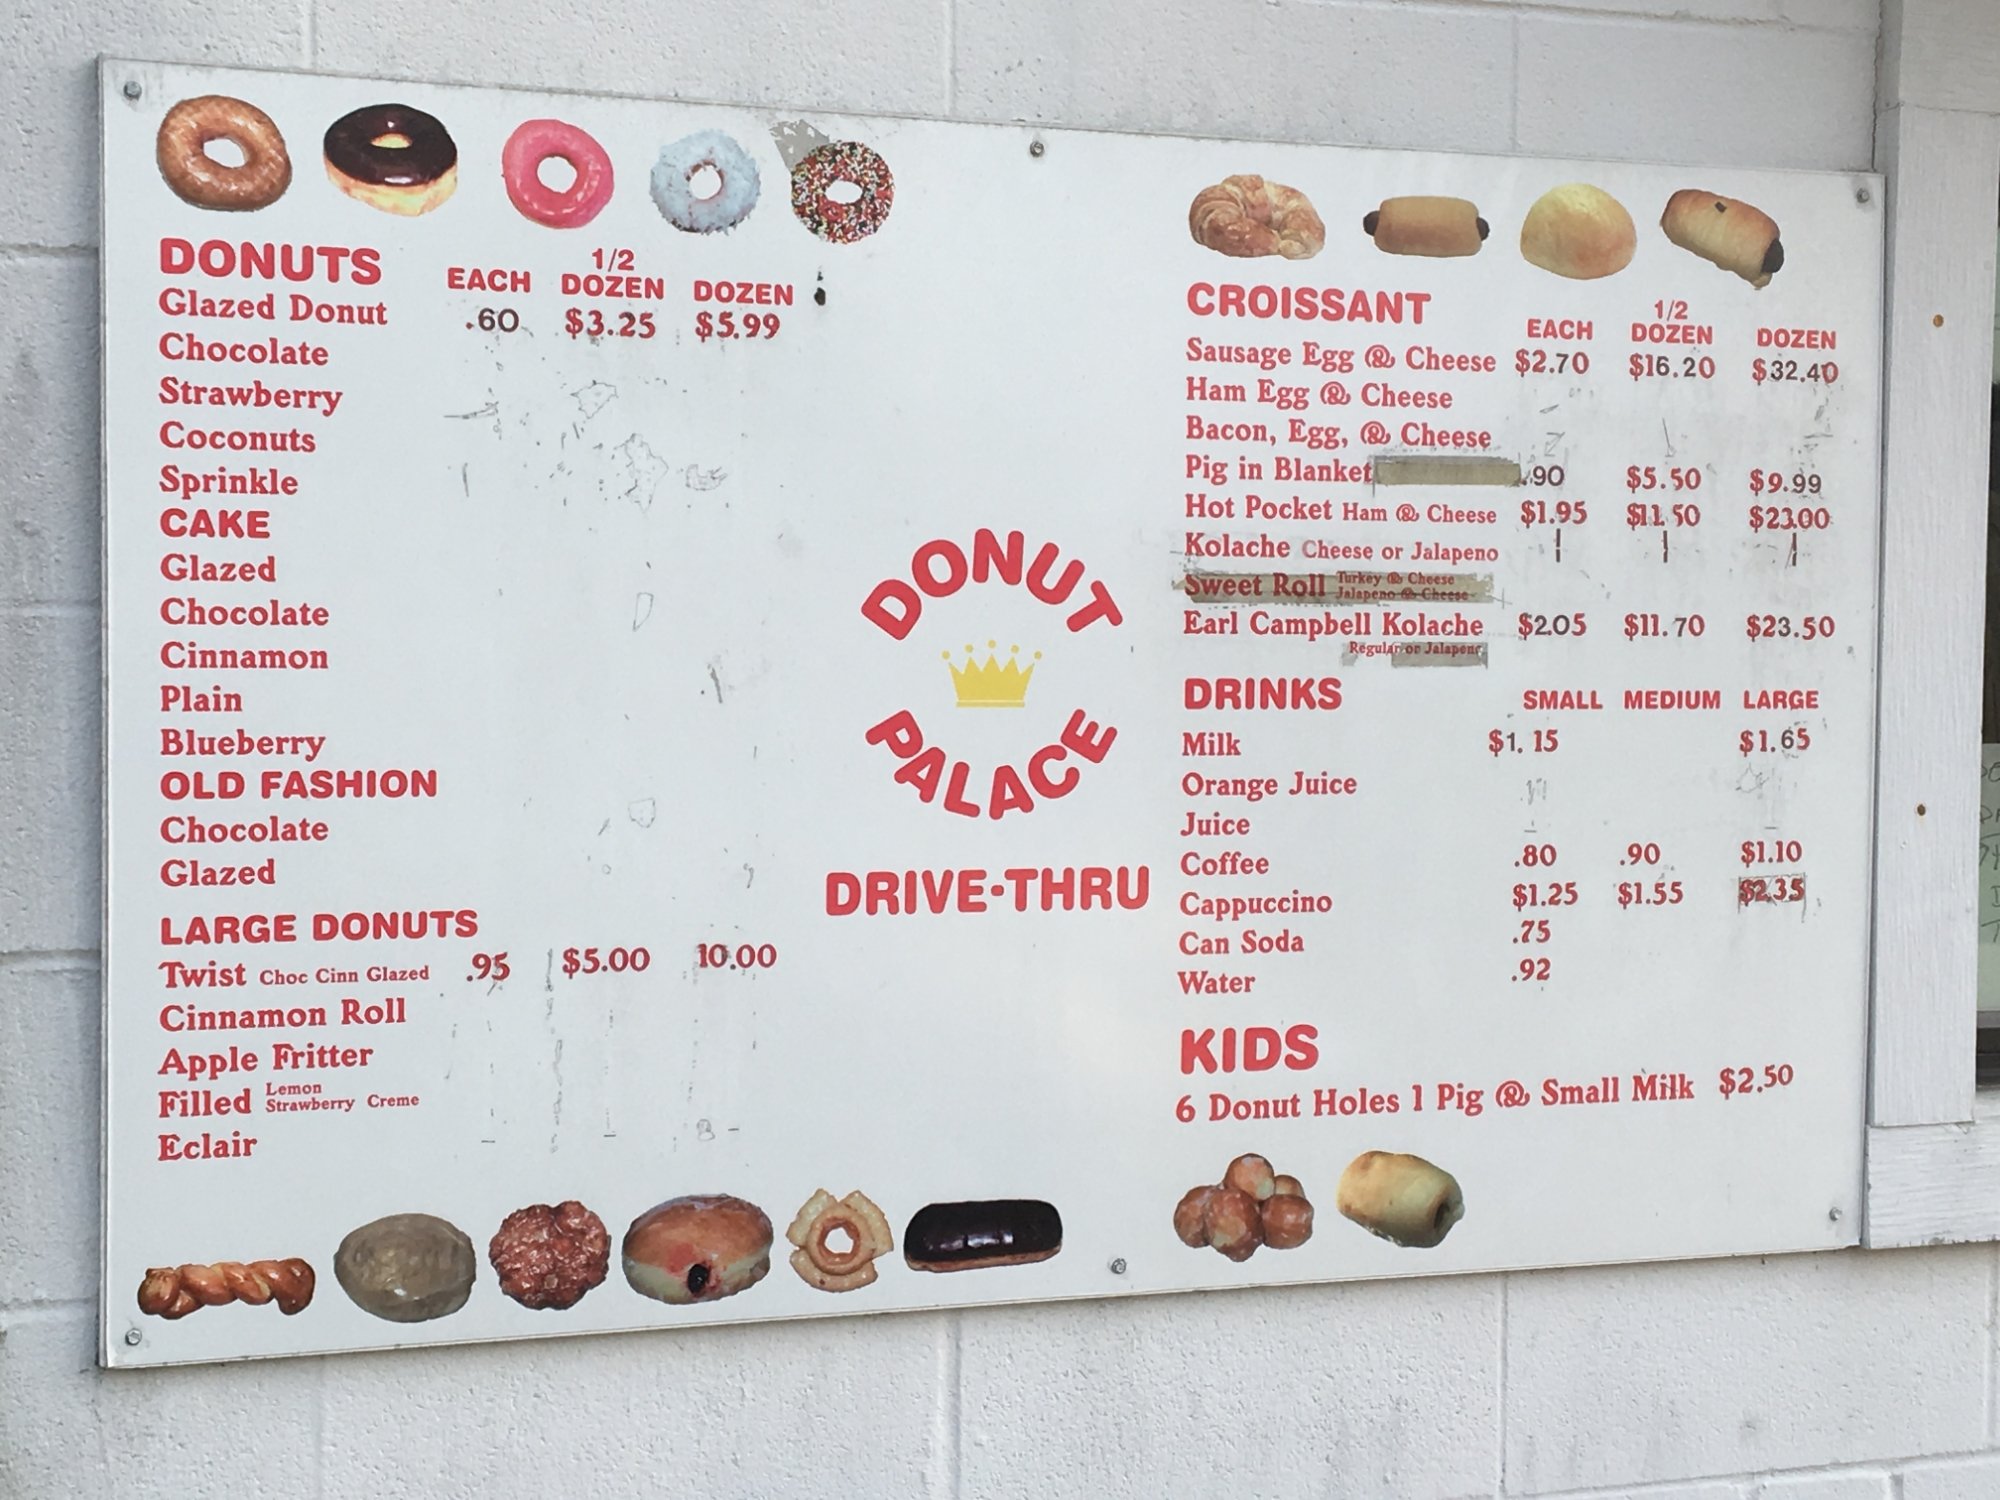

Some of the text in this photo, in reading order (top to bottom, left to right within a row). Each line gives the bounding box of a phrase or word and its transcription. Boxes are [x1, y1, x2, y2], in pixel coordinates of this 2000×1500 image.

[159, 236, 382, 286] DONUTS
[592, 248, 635, 272] 1/2
[447, 266, 531, 293] EACH
[560, 272, 665, 299] DOZEN
[693, 279, 794, 305] DOZEN
[158, 287, 387, 326] Glazed Donut
[1186, 281, 1431, 325] CROISSANT
[1655, 300, 1688, 322] 1/2
[467, 309, 518, 332] .60
[565, 307, 656, 339] $3.25
[695, 311, 780, 342] $5.99
[1526, 318, 1593, 341] EACH
[1631, 322, 1713, 345] DOZEN
[158, 331, 329, 366] Chocolate
[1756, 327, 1837, 350] DOZEN
[1186, 336, 1292, 371] Sausage
[1302, 341, 1354, 374] Egg
[1405, 344, 1495, 372] Cheese
[1515, 349, 1589, 377] $2.70
[1629, 353, 1715, 380] $16.20
[1753, 358, 1839, 383] $32.40
[159, 375, 342, 416] Strawberry
[1186, 375, 1246, 402] Ham
[1257, 378, 1310, 412] Egg
[1360, 382, 1452, 409] Cheese
[159, 420, 316, 453] Coconuts
[1186, 414, 1276, 444] Bacon,
[1288, 417, 1348, 451] Egg,
[1400, 421, 1490, 448] Cheese
[160, 464, 298, 501] Sprinkle
[1185, 453, 1372, 486] Pig in Blanket
[1627, 466, 1701, 493] $5.50
[1750, 469, 1821, 496] $9.99
[1185, 492, 1234, 519] Hot
[1244, 494, 1332, 521] Pocket
[1342, 502, 1387, 521] Ham
[1426, 503, 1496, 523] Cheese
[1520, 500, 1587, 525] $1.95
[159, 507, 271, 540] CAKE
[1185, 530, 1498, 565] Kolache Cheese or Jalapeno
[160, 553, 276, 583] Glazed
[1336, 569, 1382, 587] Turkey
[1407, 569, 1455, 585] Cheese
[860, 527, 1123, 641] DONUT
[1184, 570, 1326, 599] Sweet Roll
[1335, 585, 1394, 603] Jalapeno
[1422, 585, 1469, 602] Cheese
[160, 596, 329, 626] Chocolate
[1184, 609, 1483, 641] Earl Campbell Kolache
[1519, 612, 1586, 640] $2.05
[1624, 613, 1705, 641] $11.70
[1747, 614, 1835, 642] $23.50
[160, 640, 328, 670] Cinnamon
[1348, 640, 1401, 658] Regular
[1406, 643, 1420, 655] or
[160, 684, 242, 713] Plain
[1183, 676, 1343, 711] DRINKS
[1523, 689, 1602, 710] SMALL
[1623, 689, 1721, 710] MEDIUM
[1743, 689, 1819, 710] LARGE
[160, 727, 325, 763] Blueberry
[1183, 731, 1241, 757] Milk
[1739, 728, 1809, 756] $1.65
[864, 708, 1118, 821] PALACE
[160, 769, 438, 801] OLD FASHION
[1180, 770, 1357, 802] Orange Juice
[160, 815, 329, 844] Chocolate
[1180, 810, 1250, 837] Juice
[1179, 850, 1269, 877] Coffee
[1515, 844, 1556, 867] .80
[1621, 843, 1661, 865] .90
[1740, 840, 1802, 867] $1.10
[160, 857, 276, 887] Glazed
[825, 864, 1150, 916] DRIVE-THRU
[1513, 882, 1578, 909] $1.25
[1618, 881, 1683, 907] $1.55
[1739, 877, 1805, 907] $2.35
[1179, 890, 1332, 922] Cappuccino
[160, 908, 478, 946] LARGE DONUTS
[1514, 919, 1550, 944] .75
[698, 943, 777, 969] 10.00
[1178, 928, 1304, 956] Can Soda
[159, 960, 429, 989] Twist Choc Cinn Glazed
[467, 952, 510, 981] .95
[563, 947, 651, 976] $5.00
[1513, 957, 1550, 980] .92
[1177, 969, 1255, 994] Water
[159, 996, 406, 1032] Cinnamon Roll
[159, 1042, 373, 1082] Apple Fritter
[1180, 1023, 1319, 1075] KIDS
[265, 1082, 322, 1095] Lemon
[1719, 1064, 1793, 1098] $2.50
[159, 1087, 251, 1118] Filled
[265, 1095, 419, 1113] Strawberry Creme
[1175, 1094, 1196, 1123] 6
[1209, 1091, 1300, 1121] Donut
[1313, 1088, 1400, 1117] Holes
[1437, 1082, 1484, 1117] Pig
[1540, 1075, 1619, 1106] Small
[1632, 1072, 1694, 1101] Milk
[159, 1131, 256, 1161] Eclair
